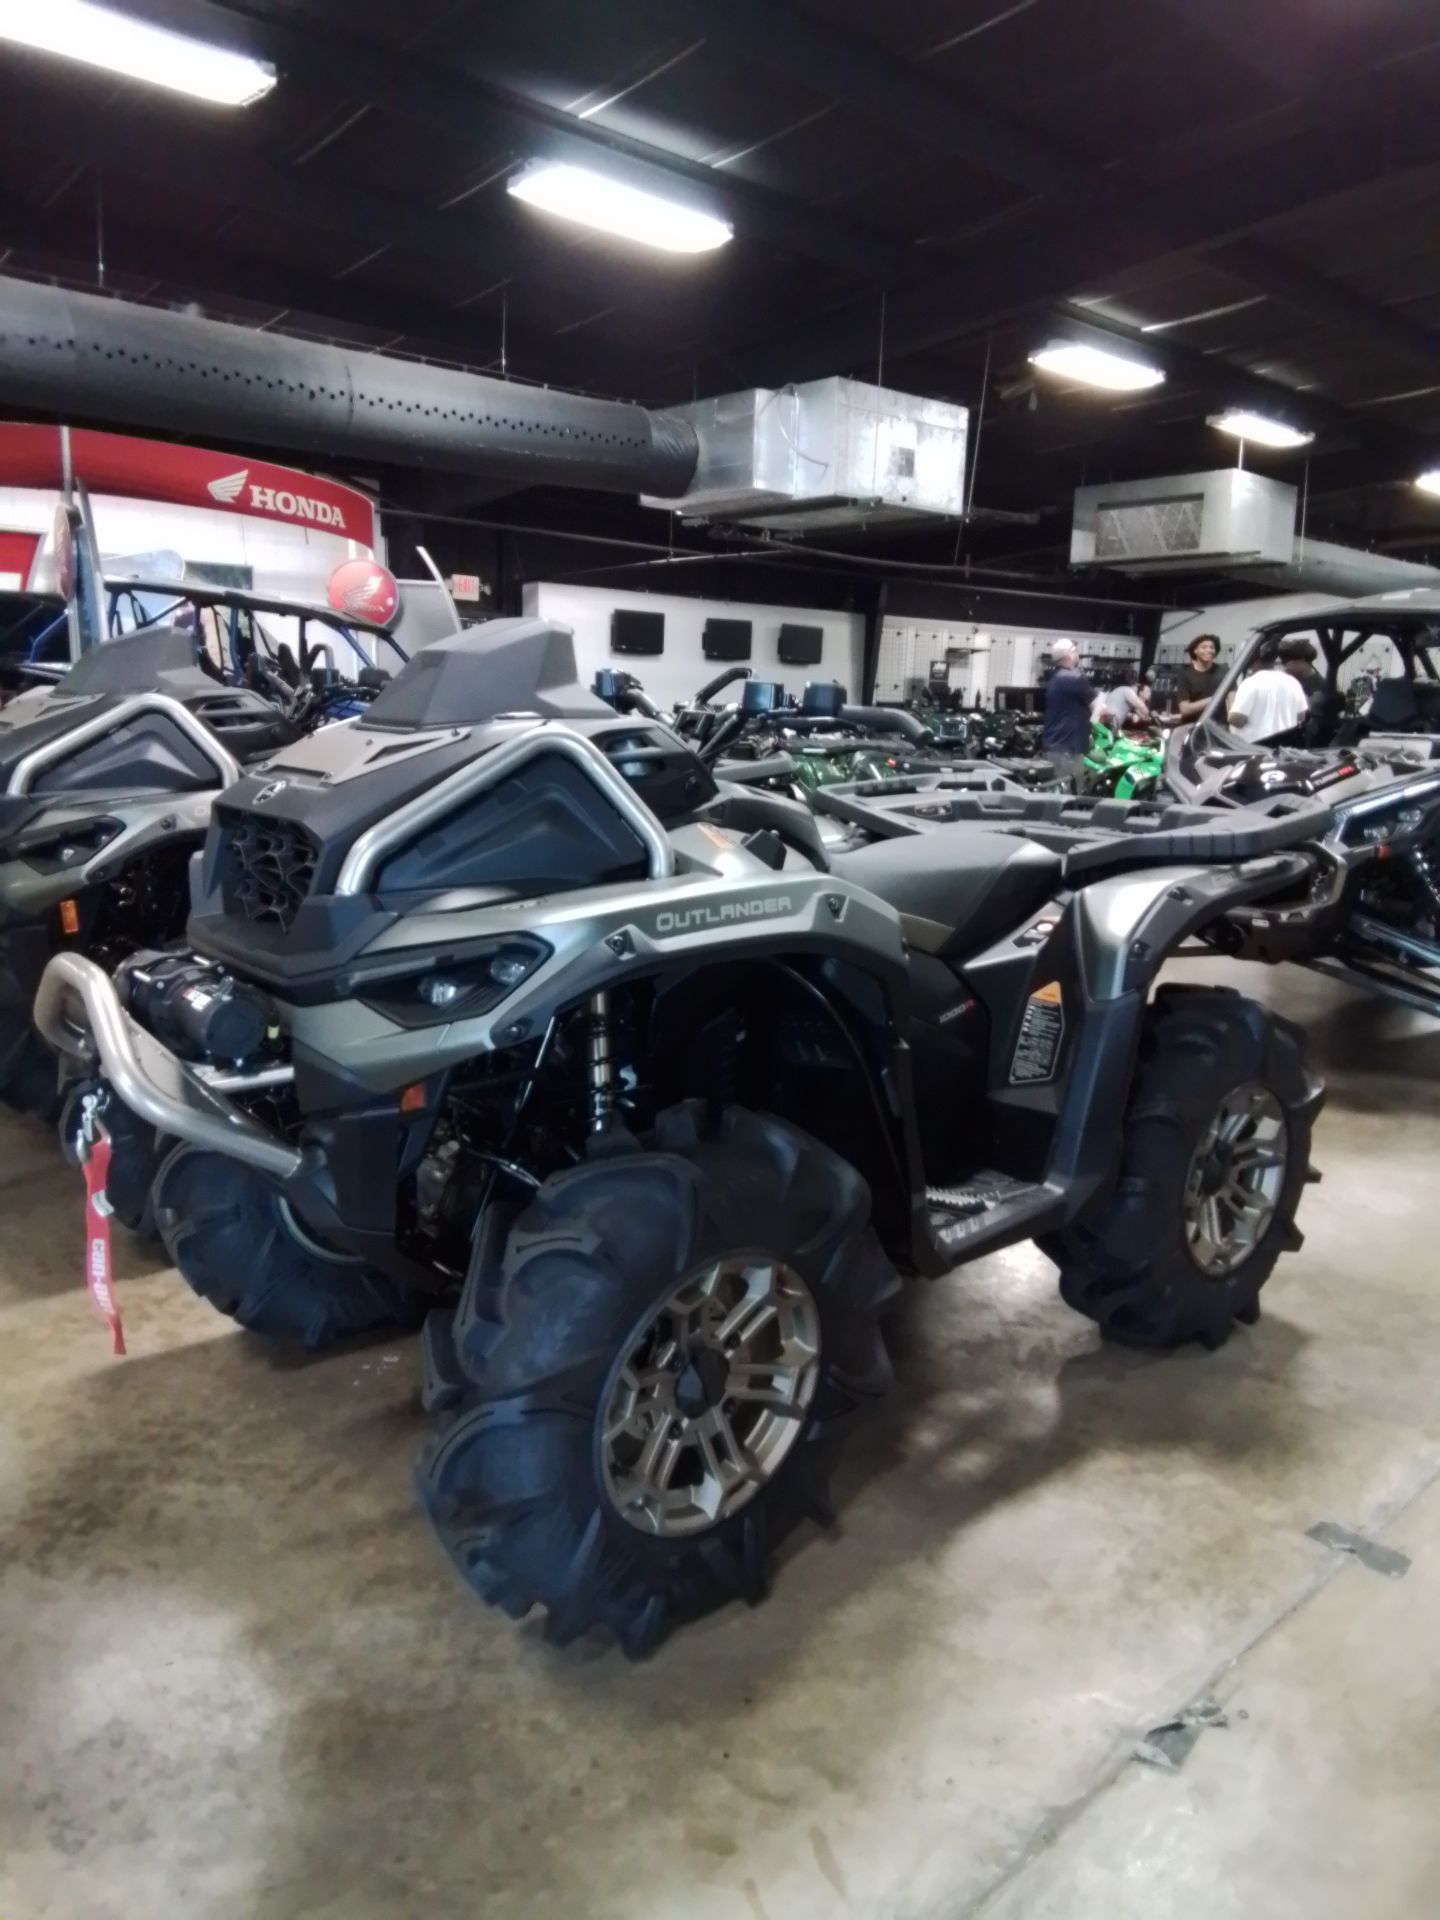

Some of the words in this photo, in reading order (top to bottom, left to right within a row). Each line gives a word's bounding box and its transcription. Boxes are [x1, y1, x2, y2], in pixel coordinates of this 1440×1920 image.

[249, 484, 346, 529] HONDA
[656, 896, 793, 932] OUTLANDER
[91, 1238, 116, 1314] can-am
